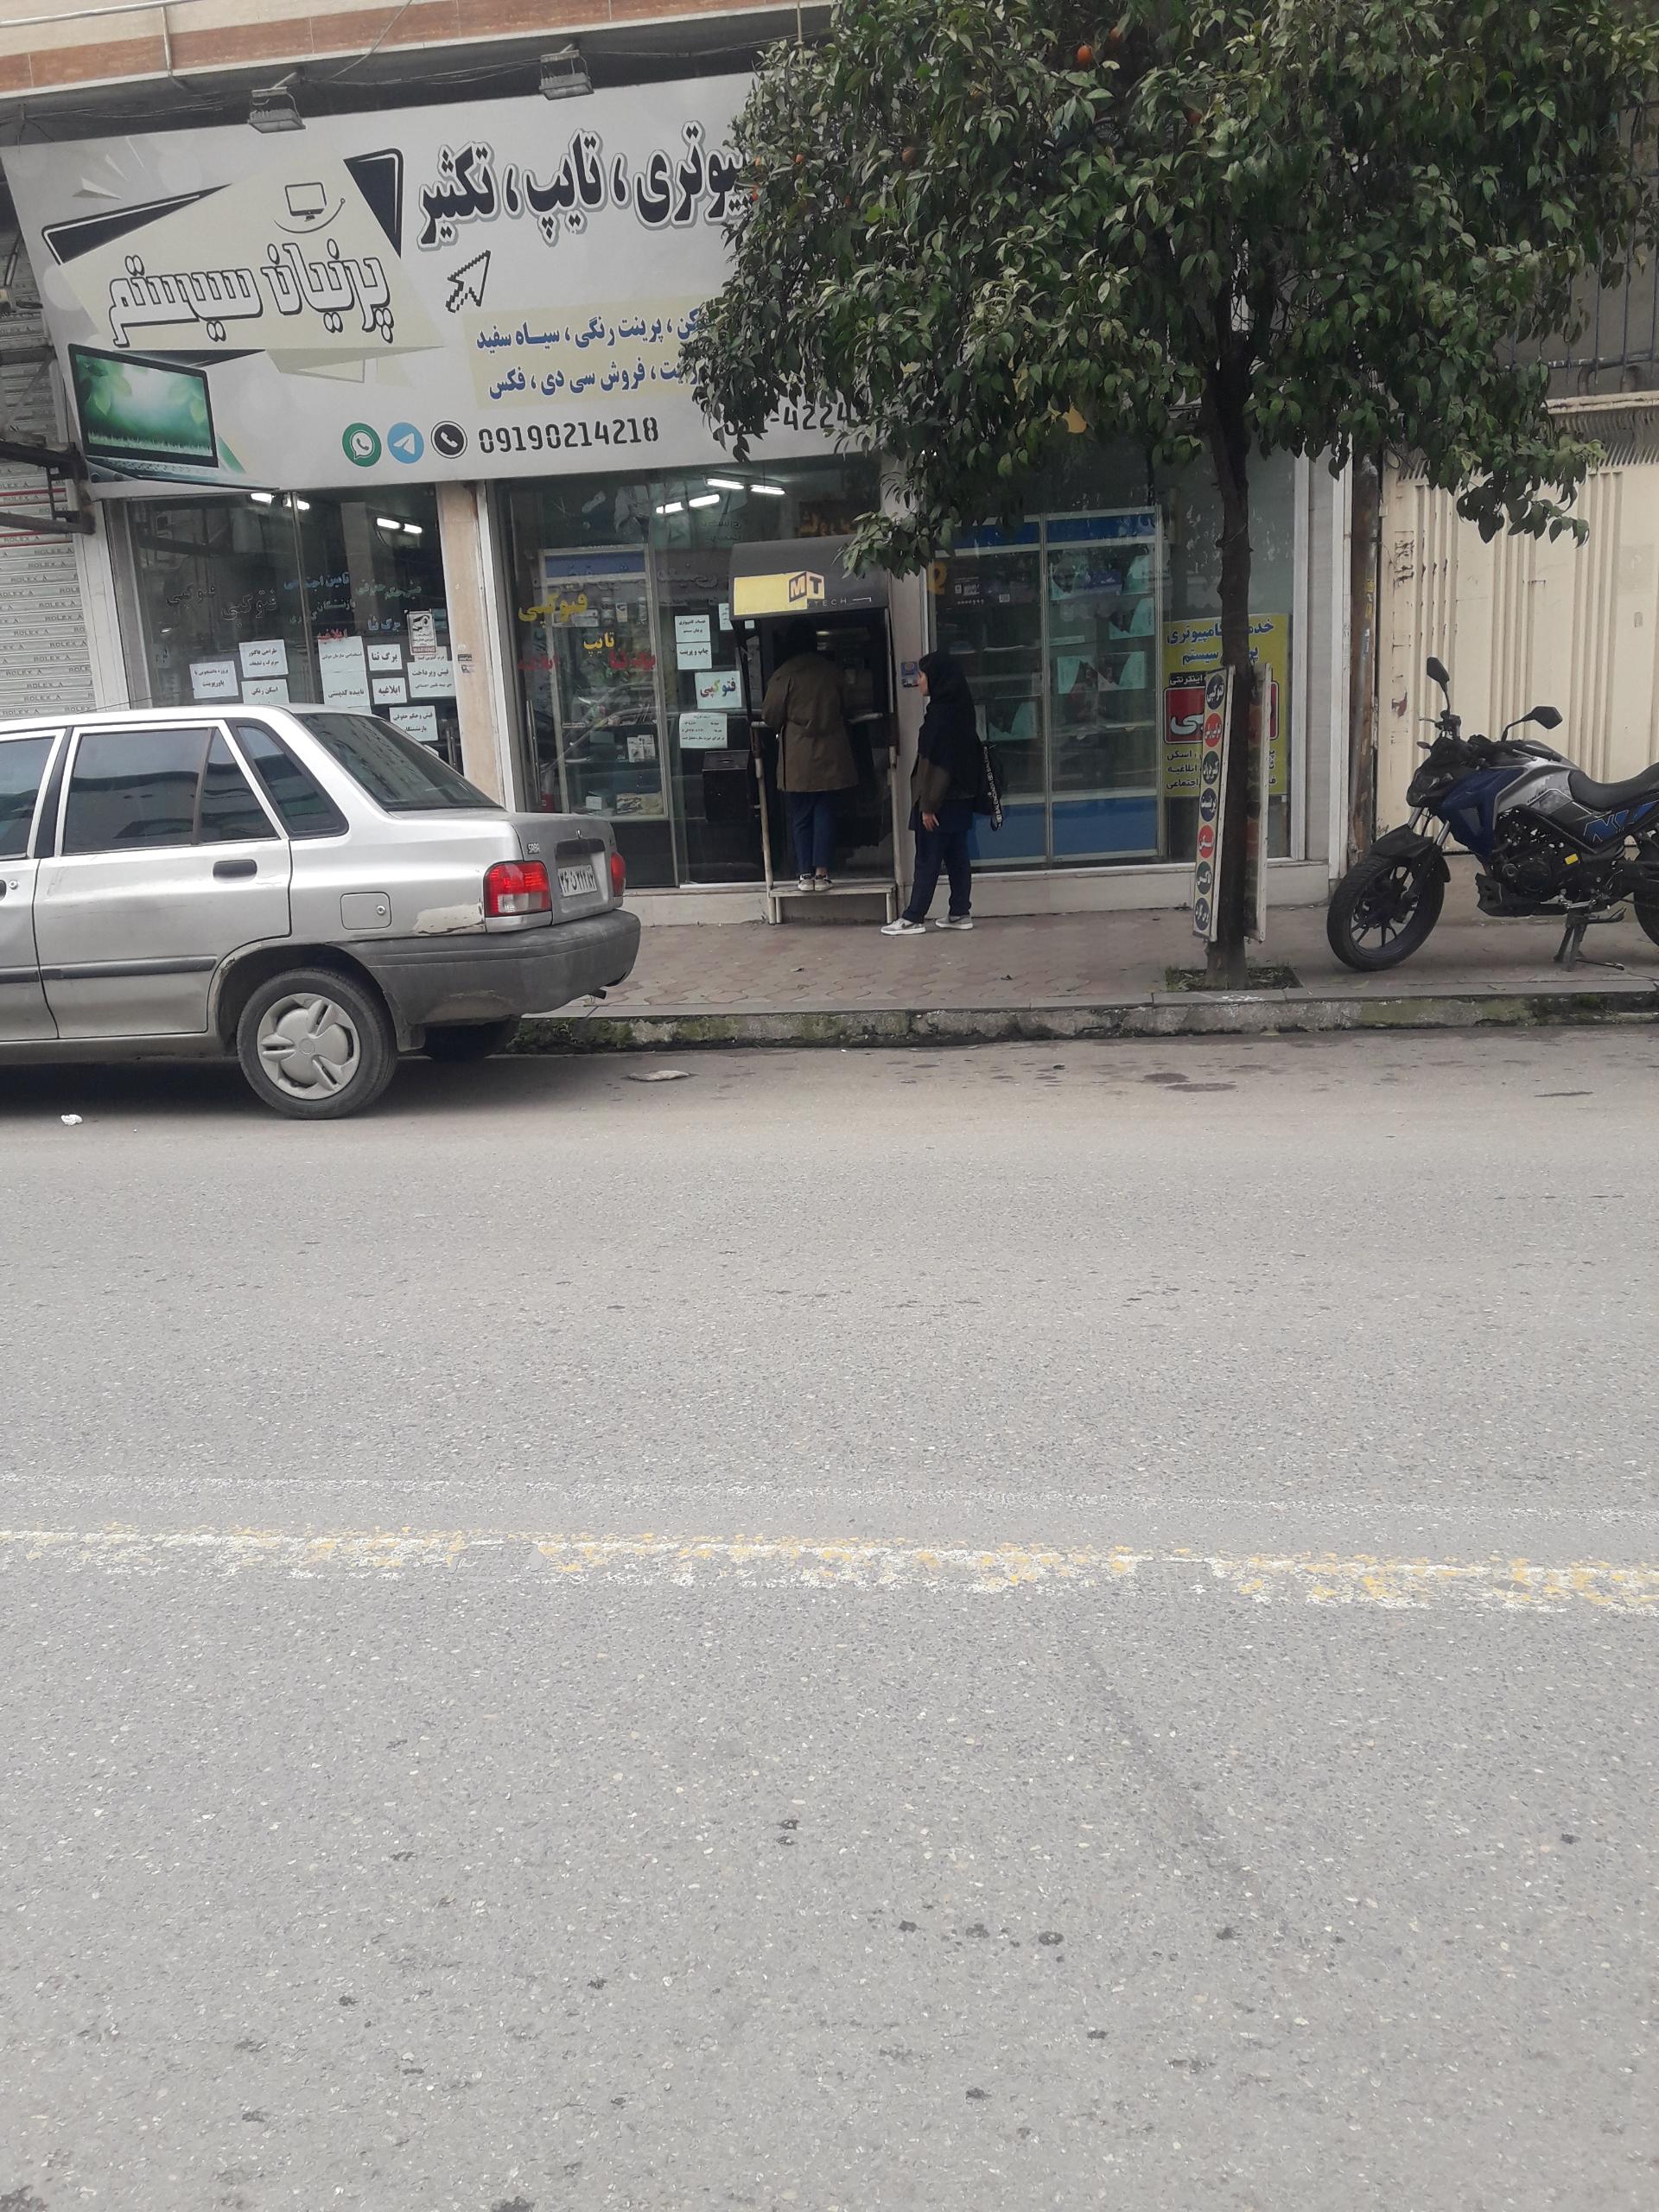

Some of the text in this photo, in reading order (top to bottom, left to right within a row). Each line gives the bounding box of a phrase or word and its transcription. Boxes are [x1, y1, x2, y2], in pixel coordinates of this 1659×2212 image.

[422, 143, 495, 245] تکثیر
[109, 239, 392, 346] پرنیان سیستم
[477, 325, 512, 353] سفید
[516, 321, 560, 349] سیاه
[575, 316, 614, 347] رنگی
[619, 316, 662, 343] پرینت
[489, 366, 526, 400] فکس
[541, 371, 564, 396] دی
[570, 372, 595, 393] سی
[601, 357, 645, 391] فروش
[479, 416, 658, 454] 09190214218
[371, 651, 398, 663] برگ ثنا
[582, 632, 615, 658] تایپ
[1182, 648, 1219, 665] سیستم
[264, 686, 278, 695] اسکن
[378, 683, 401, 696] ابلاغیه
[1169, 675, 1203, 686] اینترنتی
[1166, 749, 1192, 761] اسکن
[1167, 764, 1197, 775] ابلاغیه
[1166, 779, 1198, 789] اجتماعی
